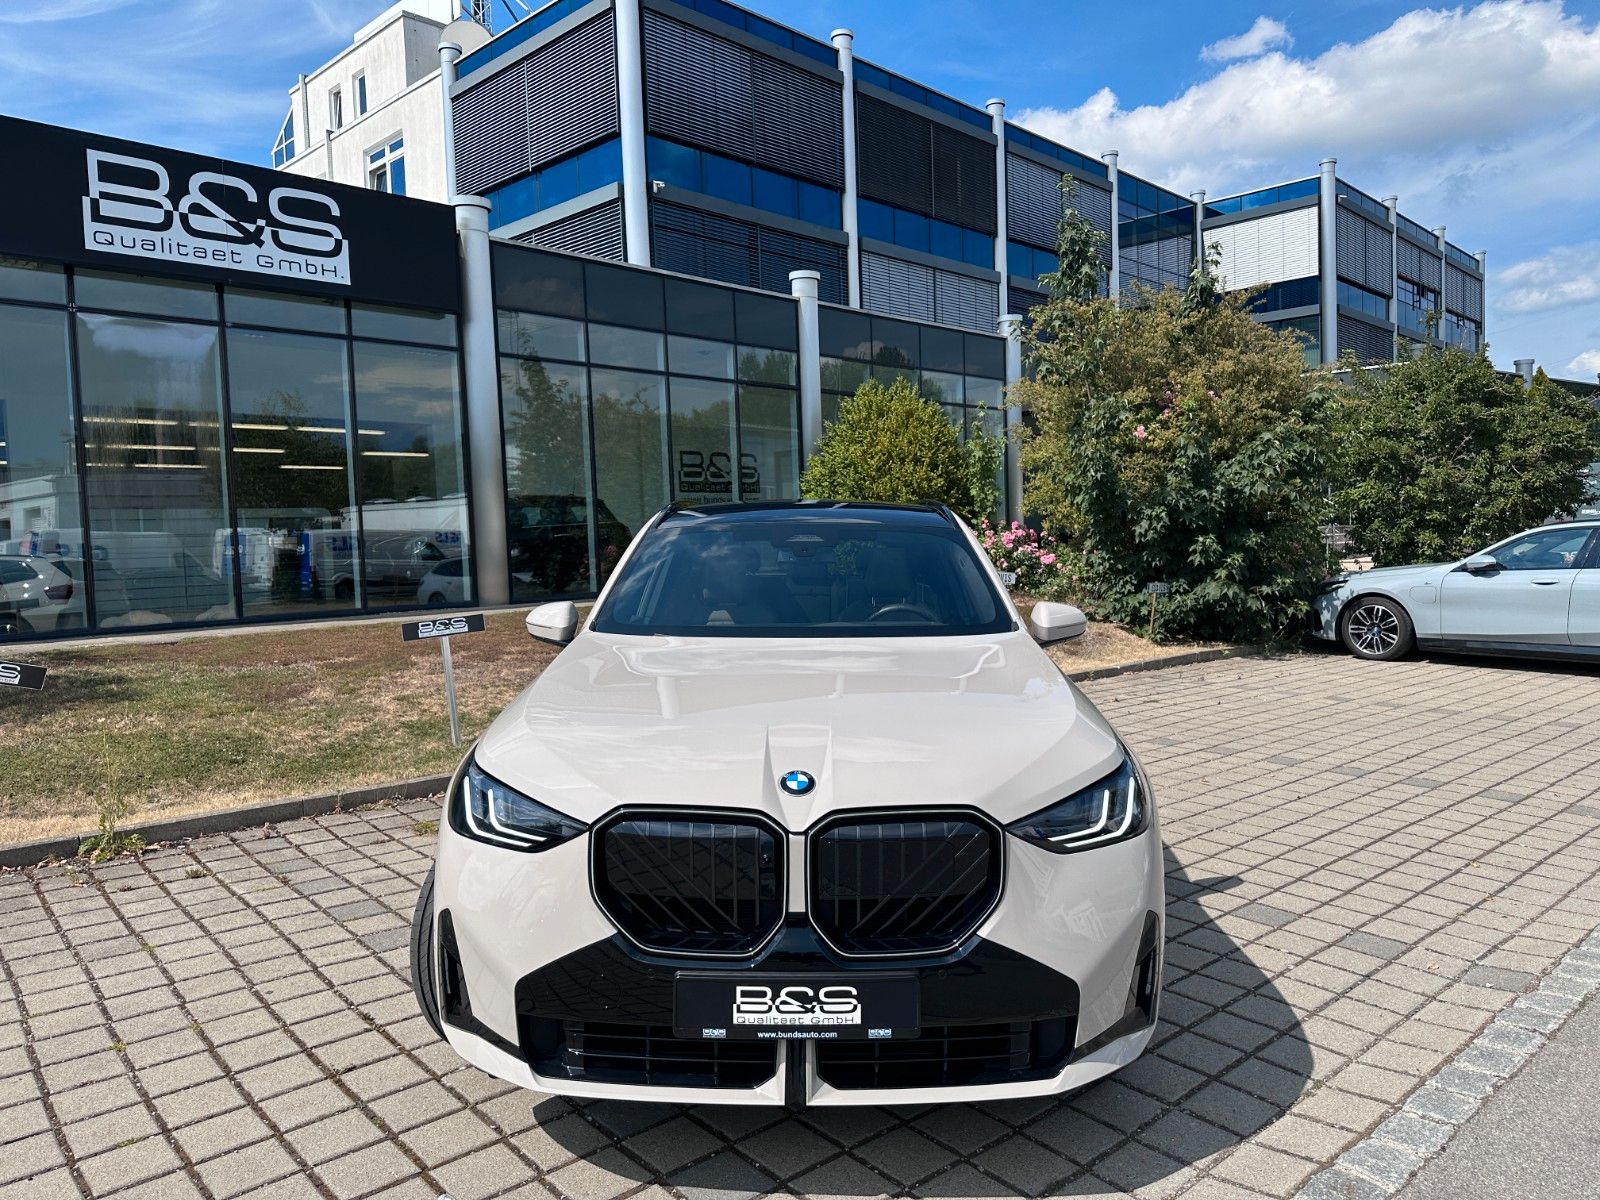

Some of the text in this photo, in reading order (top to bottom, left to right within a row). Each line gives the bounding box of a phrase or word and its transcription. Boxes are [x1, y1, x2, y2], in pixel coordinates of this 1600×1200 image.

[86, 148, 343, 259] B&S
[93, 230, 345, 279] Qualitaet GmbH.
[418, 617, 467, 633] B&S
[736, 986, 859, 1015] B&S
[736, 1015, 804, 1024] Qualitaet
[757, 1030, 838, 1039] www.bundsauto.com
